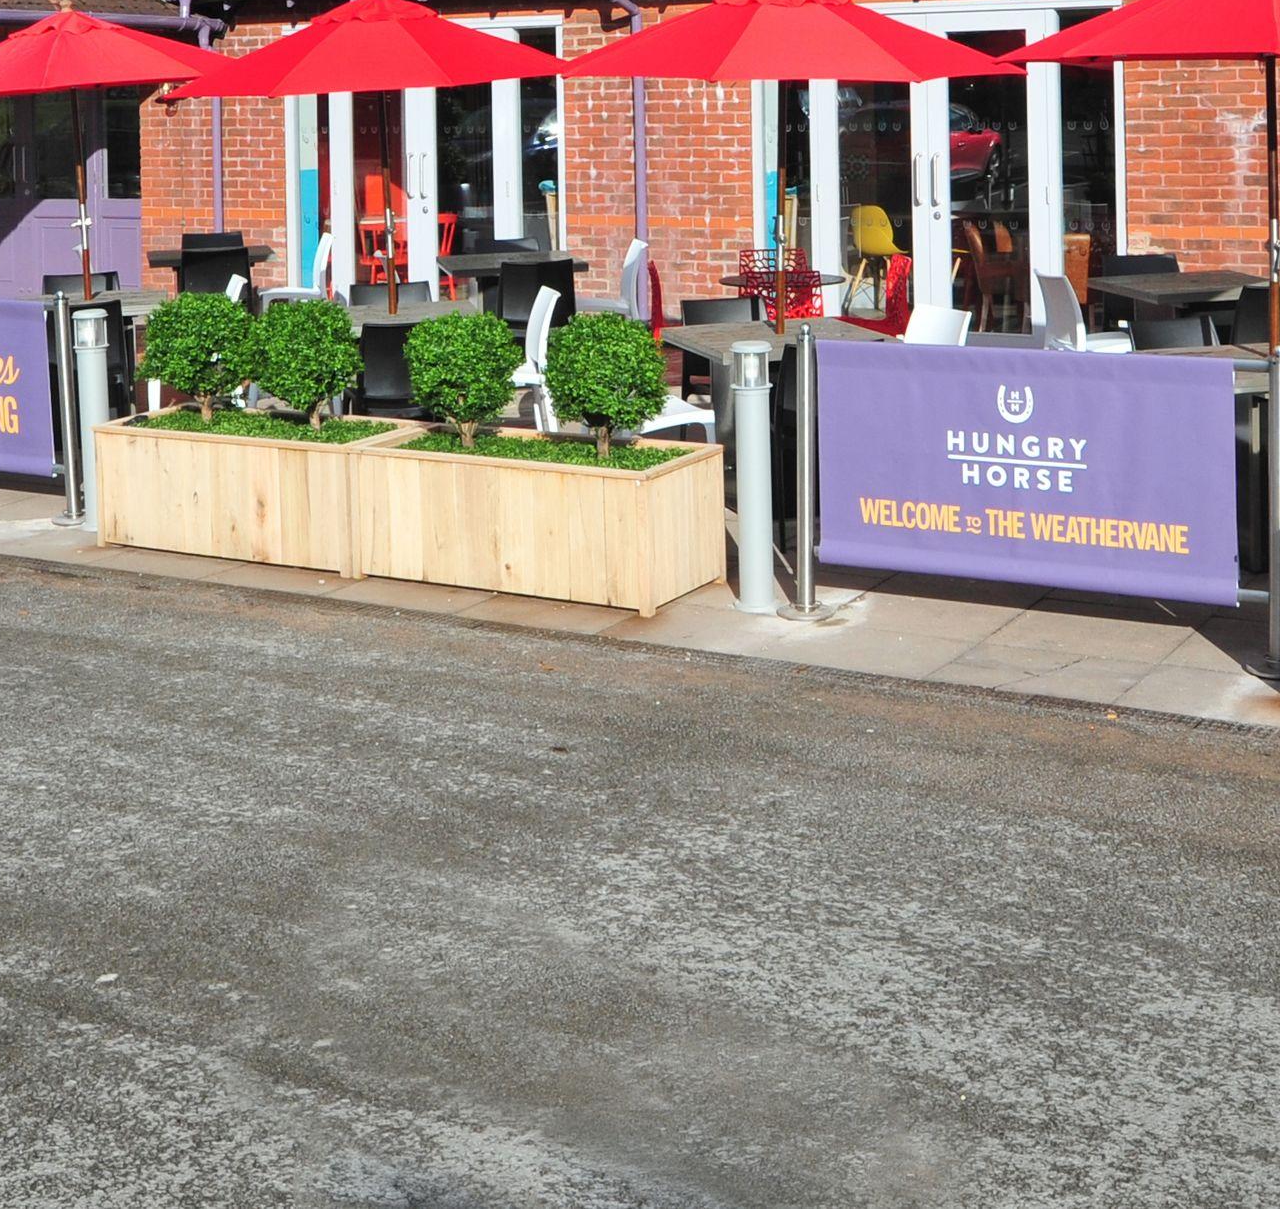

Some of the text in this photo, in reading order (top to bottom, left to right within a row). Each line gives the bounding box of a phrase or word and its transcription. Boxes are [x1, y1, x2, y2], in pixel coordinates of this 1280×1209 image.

[946, 430, 1088, 461] HUNGRY
[962, 462, 1074, 493] HORSE
[859, 497, 1189, 555] WELCOME TO THE WEATHERVANE
